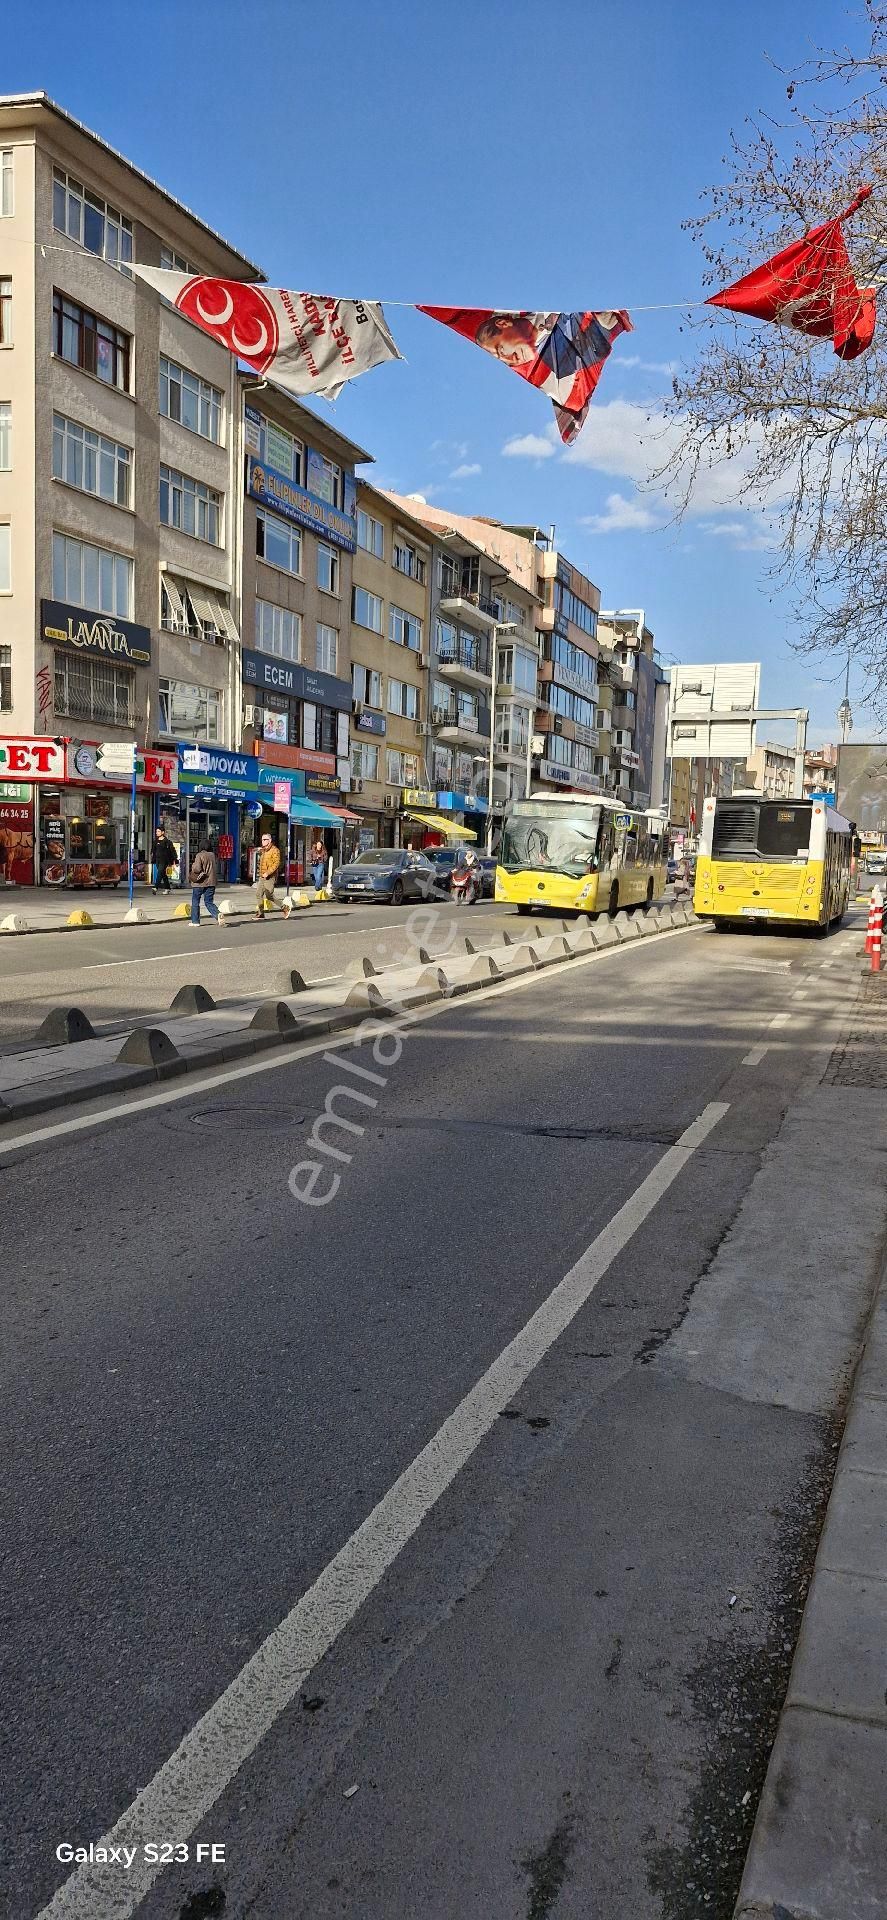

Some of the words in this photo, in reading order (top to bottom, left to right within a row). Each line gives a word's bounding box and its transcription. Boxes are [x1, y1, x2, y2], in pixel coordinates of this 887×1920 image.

[67, 618, 132, 656] LAVANTA
[264, 664, 293, 688] ECEM
[7, 746, 57, 772] ET
[143, 757, 175, 785] ET
[209, 756, 248, 775] WOYAX
[0, 809, 9, 818] 64
[10, 809, 19, 818] 34
[20, 810, 29, 819] 25
